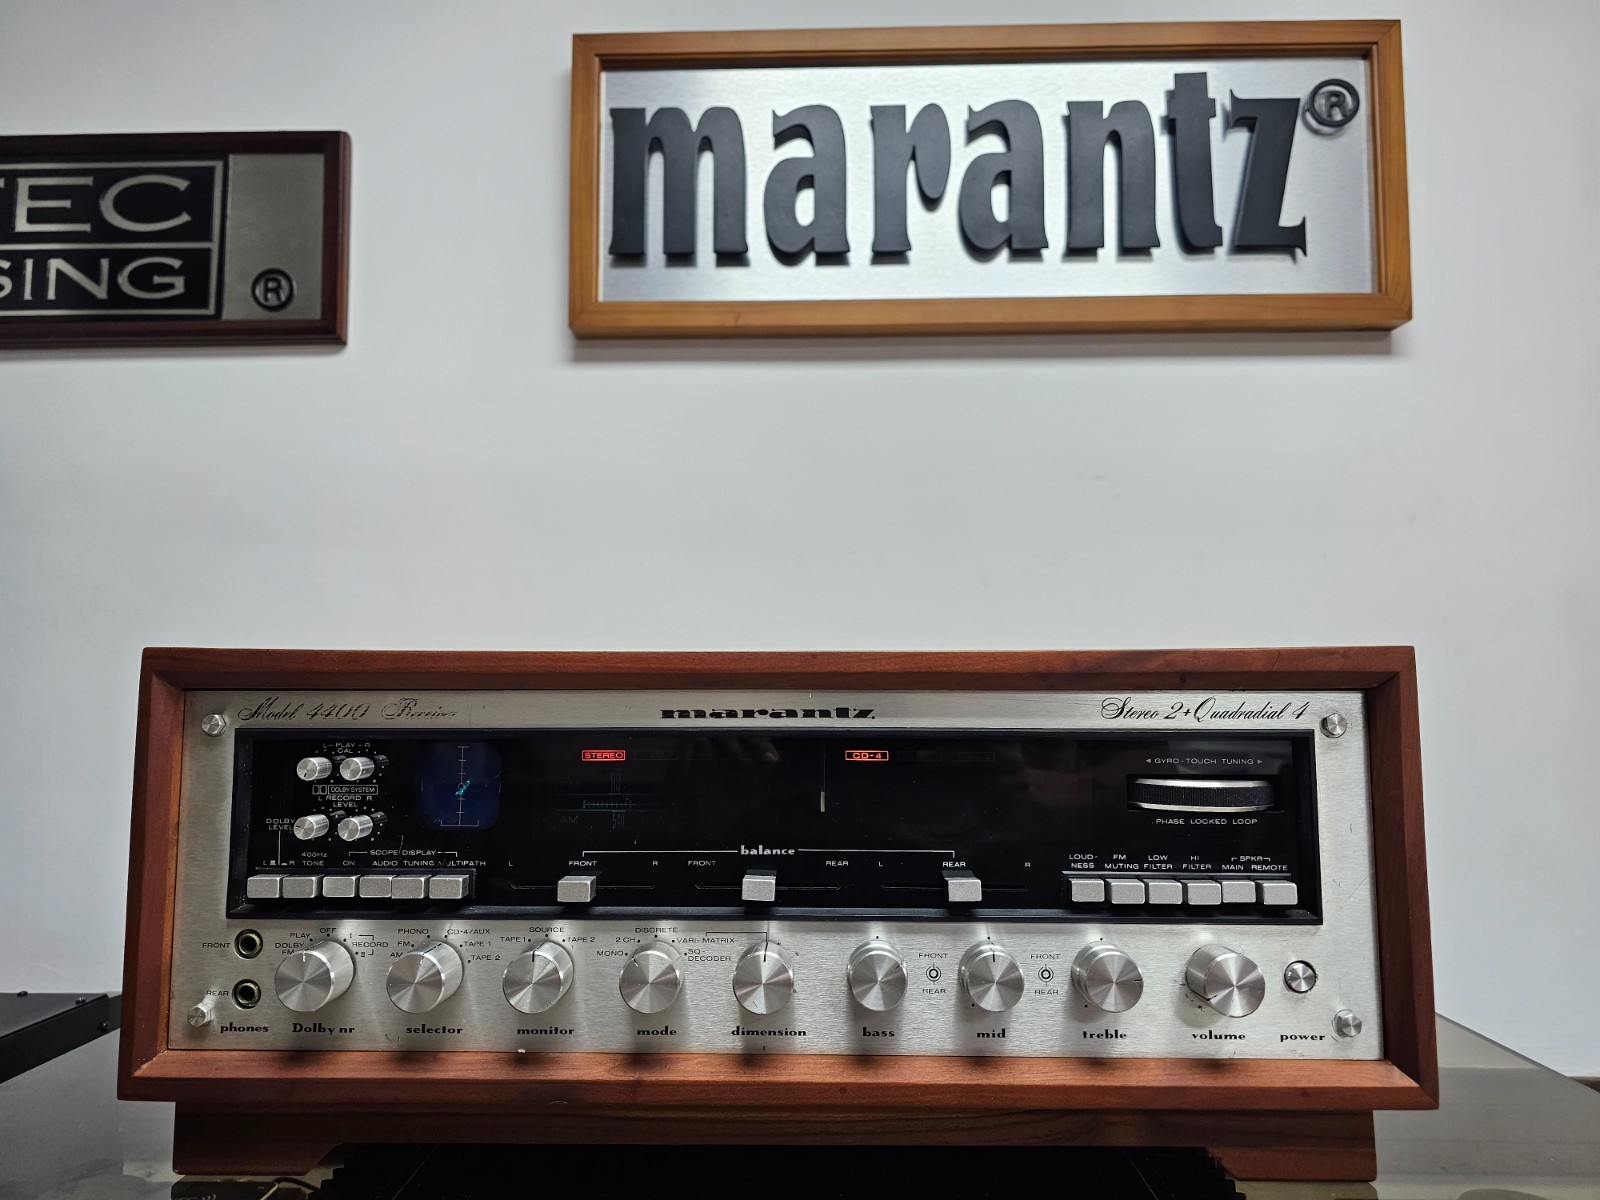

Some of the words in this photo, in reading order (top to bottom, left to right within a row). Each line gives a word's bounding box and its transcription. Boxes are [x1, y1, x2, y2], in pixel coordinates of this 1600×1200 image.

[609, 72, 1307, 258] marantz
[0, 173, 192, 233] EC
[238, 696, 304, 721] Model
[660, 707, 875, 719] marantz
[1100, 696, 1159, 720] Stereo
[583, 751, 624, 760] STEREO
[852, 752, 882, 760] CD-4
[1221, 757, 1254, 765] TUNING
[740, 845, 796, 856] balance
[219, 1022, 270, 1034] phones
[291, 1022, 336, 1037] Dolby
[339, 1025, 355, 1034] nr
[405, 1023, 464, 1035] selector
[516, 1026, 575, 1035] monitor
[637, 1025, 677, 1036] mode
[731, 1025, 807, 1037] dimension
[862, 1026, 895, 1038] bass
[976, 1028, 1006, 1039] mid
[1082, 1028, 1127, 1040] treble
[1191, 1029, 1246, 1041] volume
[1279, 1033, 1325, 1043] power
